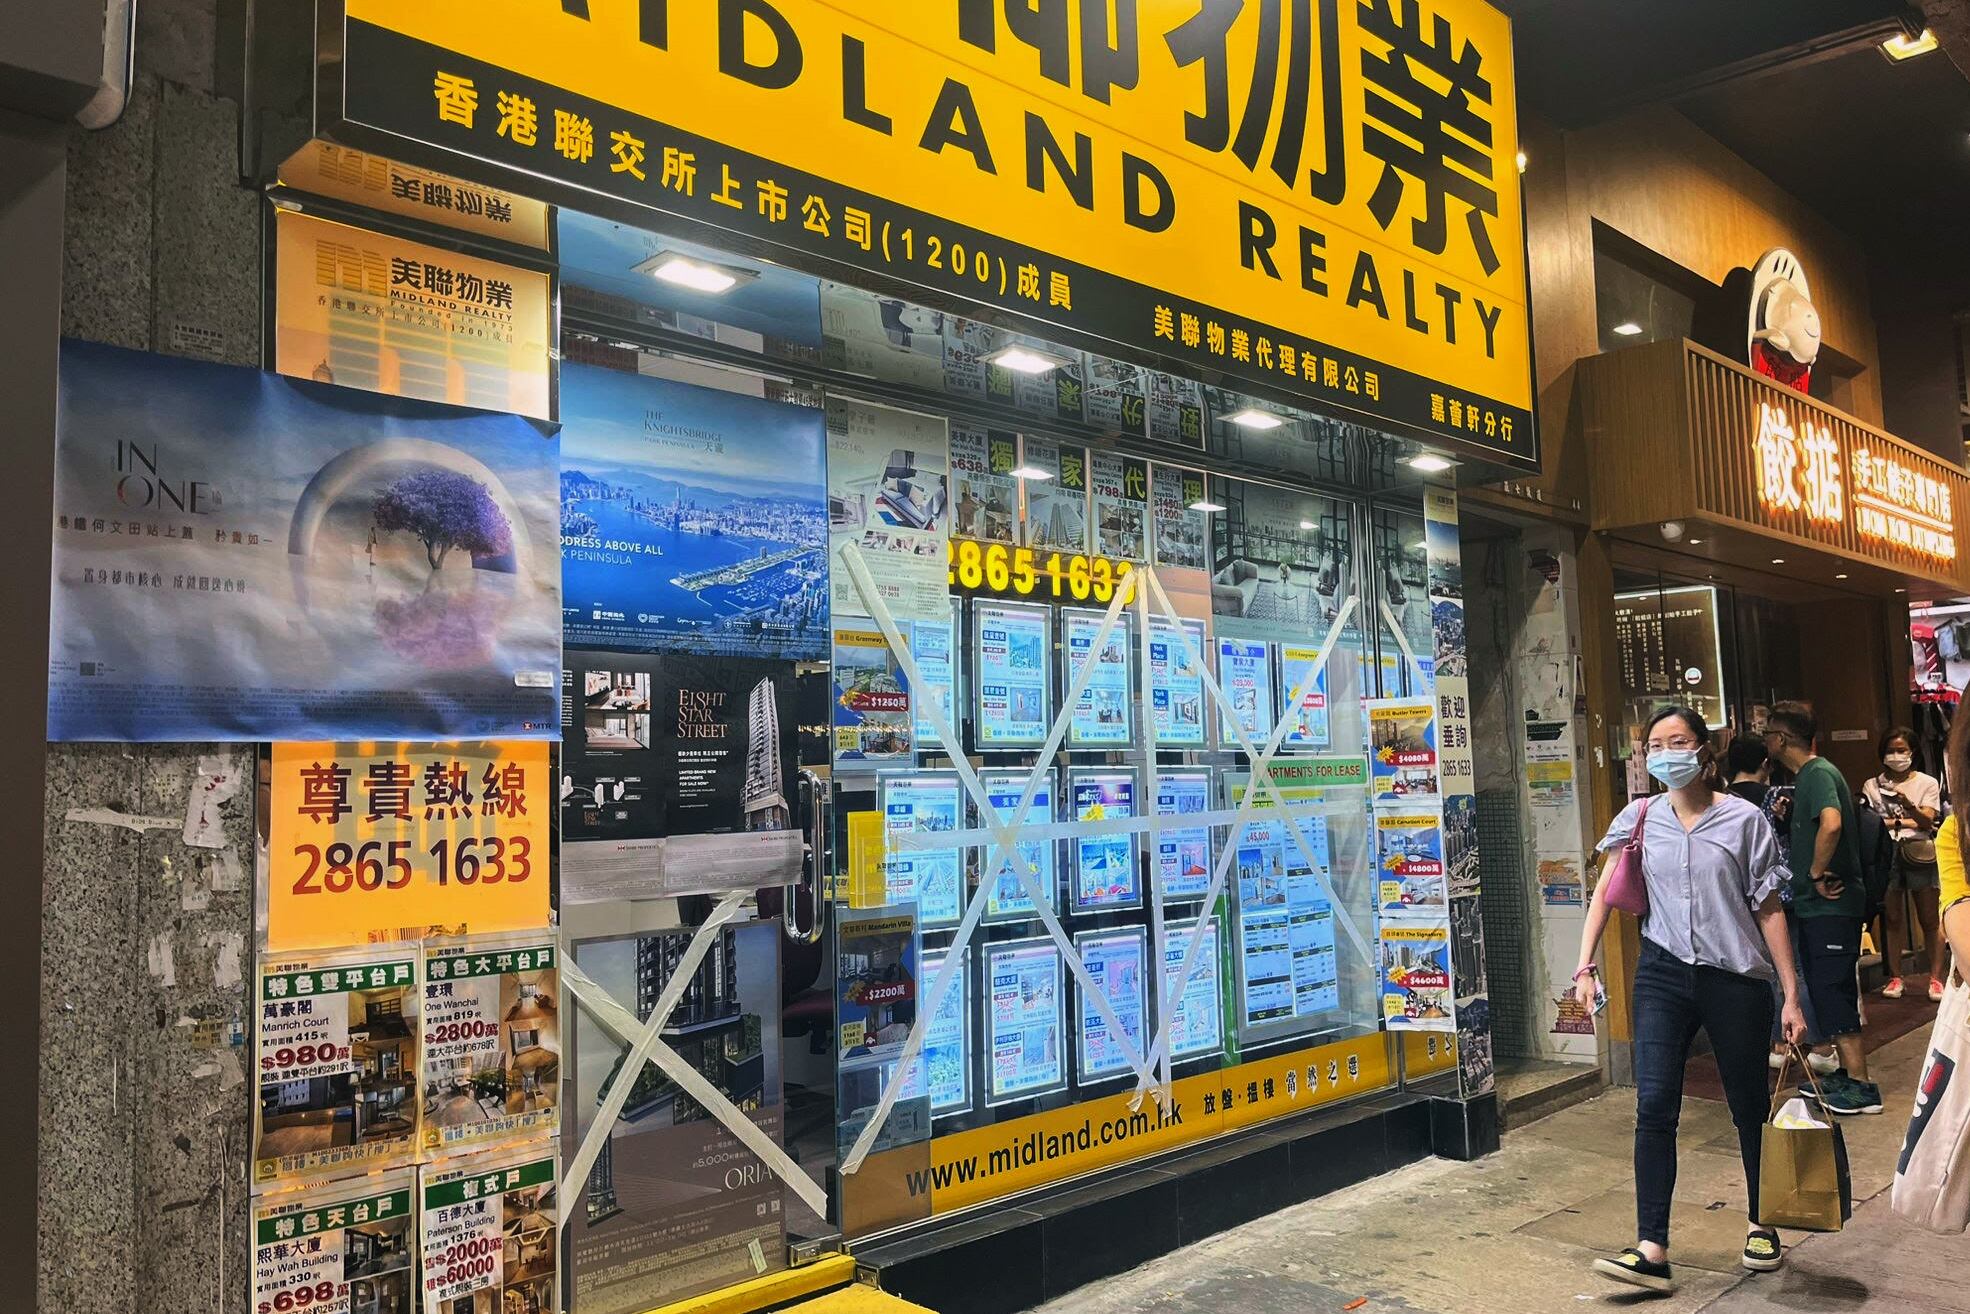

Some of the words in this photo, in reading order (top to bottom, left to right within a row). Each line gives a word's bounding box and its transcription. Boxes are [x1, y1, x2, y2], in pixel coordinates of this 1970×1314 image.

[433, 70, 1073, 312] 香港聯交所上市公司(1200)成員
[391, 257, 513, 310] 美聯物業
[1239, 200, 1502, 359] REALTY
[390, 289, 457, 310] MIDLAND
[464, 304, 513, 322] REALTY
[1154, 305, 1381, 402] 美聯物業代理有限公司
[1430, 393, 1514, 444] 嘉薈軒分行
[645, 409, 665, 421] THE
[644, 421, 724, 443] KNIGHTSBRIDGE
[117, 439, 157, 476] IN
[1061, 454, 1084, 487] 家
[1125, 467, 1146, 499] 代
[116, 475, 209, 515] ONE
[570, 549, 633, 565] PENINSULA
[605, 540, 642, 555] ABOVE
[644, 544, 664, 556] ALL
[678, 706, 713, 722] STAR
[1441, 695, 1466, 719] 歡迎
[677, 721, 728, 738] STREET
[1443, 723, 1468, 748] 垂詢
[1316, 766, 1333, 777] FOR
[1334, 764, 1361, 776] LEASE
[1443, 759, 1457, 777] 2865
[1458, 759, 1471, 777] 1633
[298, 761, 527, 825] 尊貴熱線
[292, 840, 413, 895] 2865
[429, 835, 532, 887] 1633
[430, 949, 551, 980] 特色大平台戶
[268, 963, 411, 998] 特色雙平台戶
[425, 982, 454, 999] 壹環
[262, 999, 313, 1020] 萬豪閣
[424, 1002, 442, 1013] One
[443, 997, 479, 1010] Wanchai
[453, 1009, 474, 1021] 819
[262, 1020, 301, 1034] Manrich
[303, 1016, 330, 1029] Court
[295, 1031, 319, 1043] 415
[424, 1020, 500, 1046] $2800萬
[261, 1042, 351, 1071] $980萬
[1285, 1055, 1358, 1097] 當然之選
[906, 1099, 1183, 1196] www.midland.com.hk
[275, 1196, 394, 1239] 特色天台戶
[437, 1199, 486, 1224] 百德大廈
[427, 1221, 463, 1239] Paterson
[464, 1214, 496, 1231] Building
[450, 1231, 476, 1245] 1376
[256, 1236, 323, 1266] 熙華大廈
[256, 1265, 277, 1280] Hay
[278, 1261, 300, 1274] Wah
[301, 1251, 339, 1270] Building
[288, 1271, 312, 1286] 330
